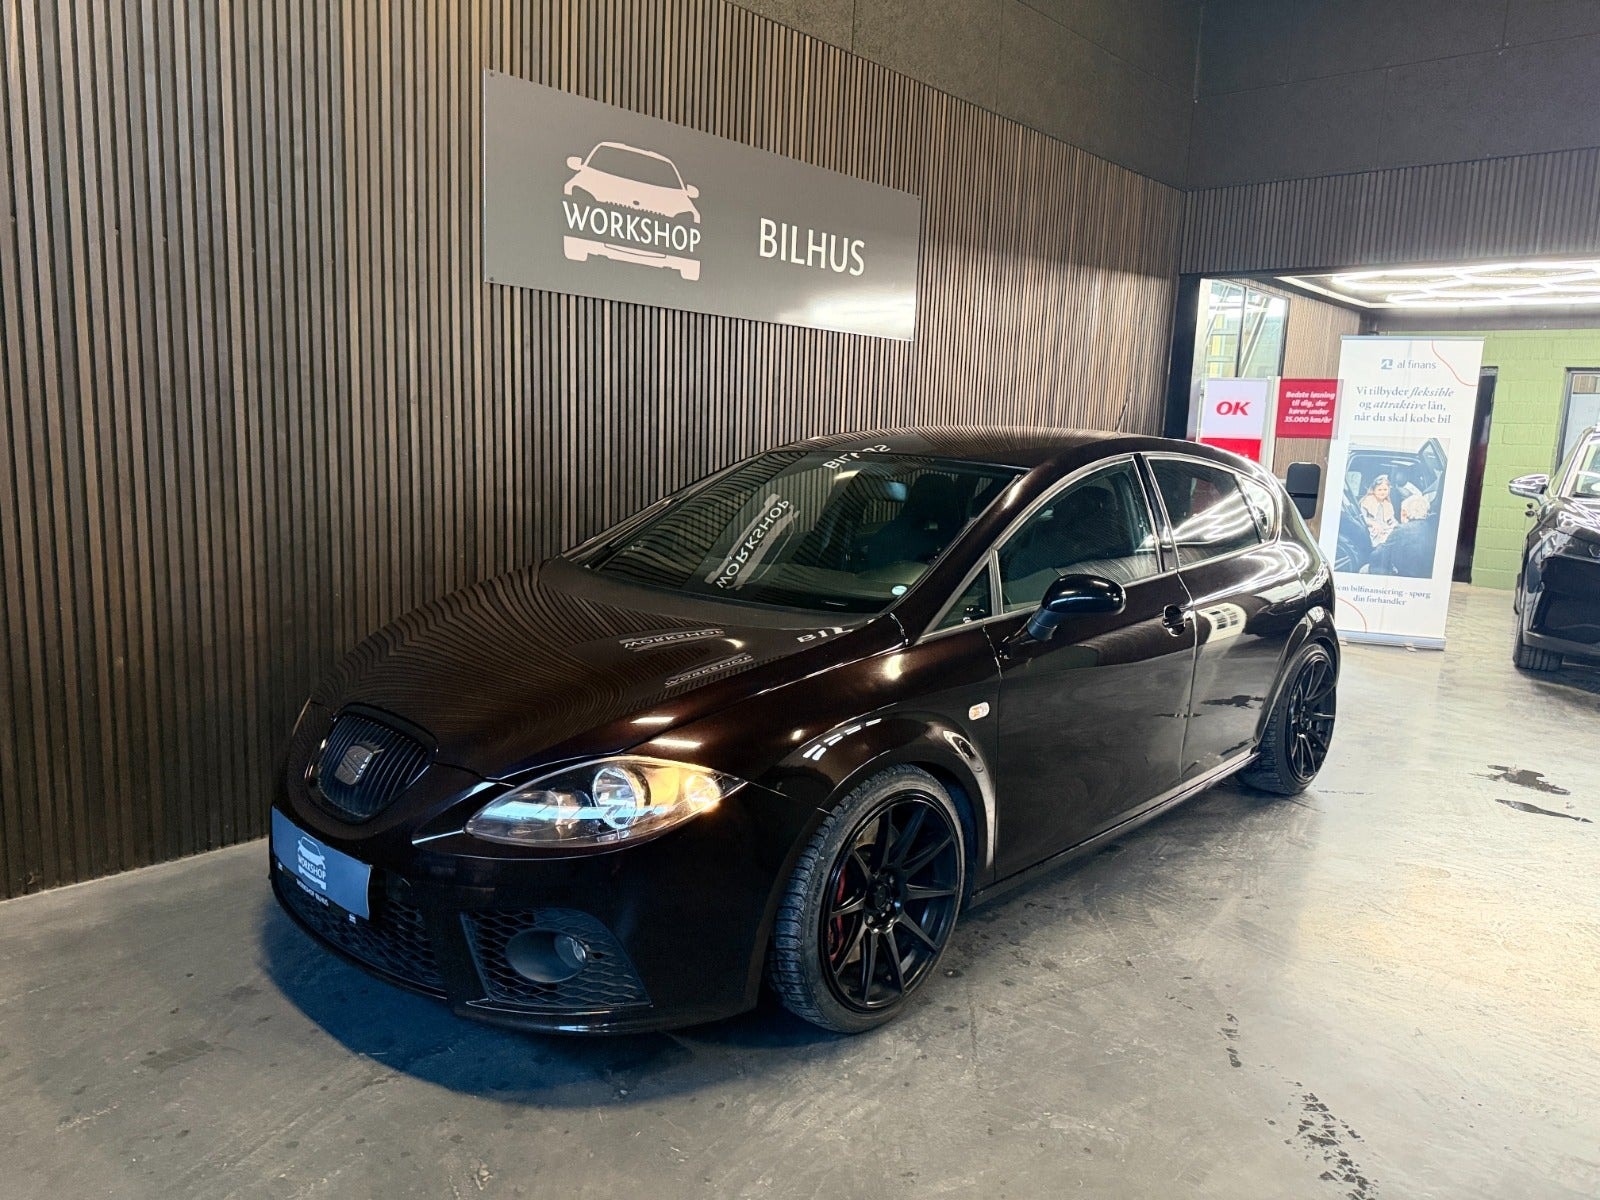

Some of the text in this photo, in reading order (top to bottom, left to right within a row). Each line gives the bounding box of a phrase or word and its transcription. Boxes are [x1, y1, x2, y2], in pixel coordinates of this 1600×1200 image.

[562, 200, 701, 253] WORKSHOP
[759, 217, 865, 276] BILHUS
[1396, 360, 1437, 369] al finans
[1356, 386, 1455, 399] Vi tilbyder fleksible
[1216, 401, 1251, 416] OK
[1359, 401, 1372, 411] og
[1373, 400, 1426, 409] attraktive
[1354, 412, 1371, 421] når
[1372, 412, 1386, 422] du
[1388, 413, 1408, 423] skal
[1437, 414, 1452, 424] bil
[1366, 595, 1406, 606] forhandler
[297, 853, 326, 880] WORKSHOP
